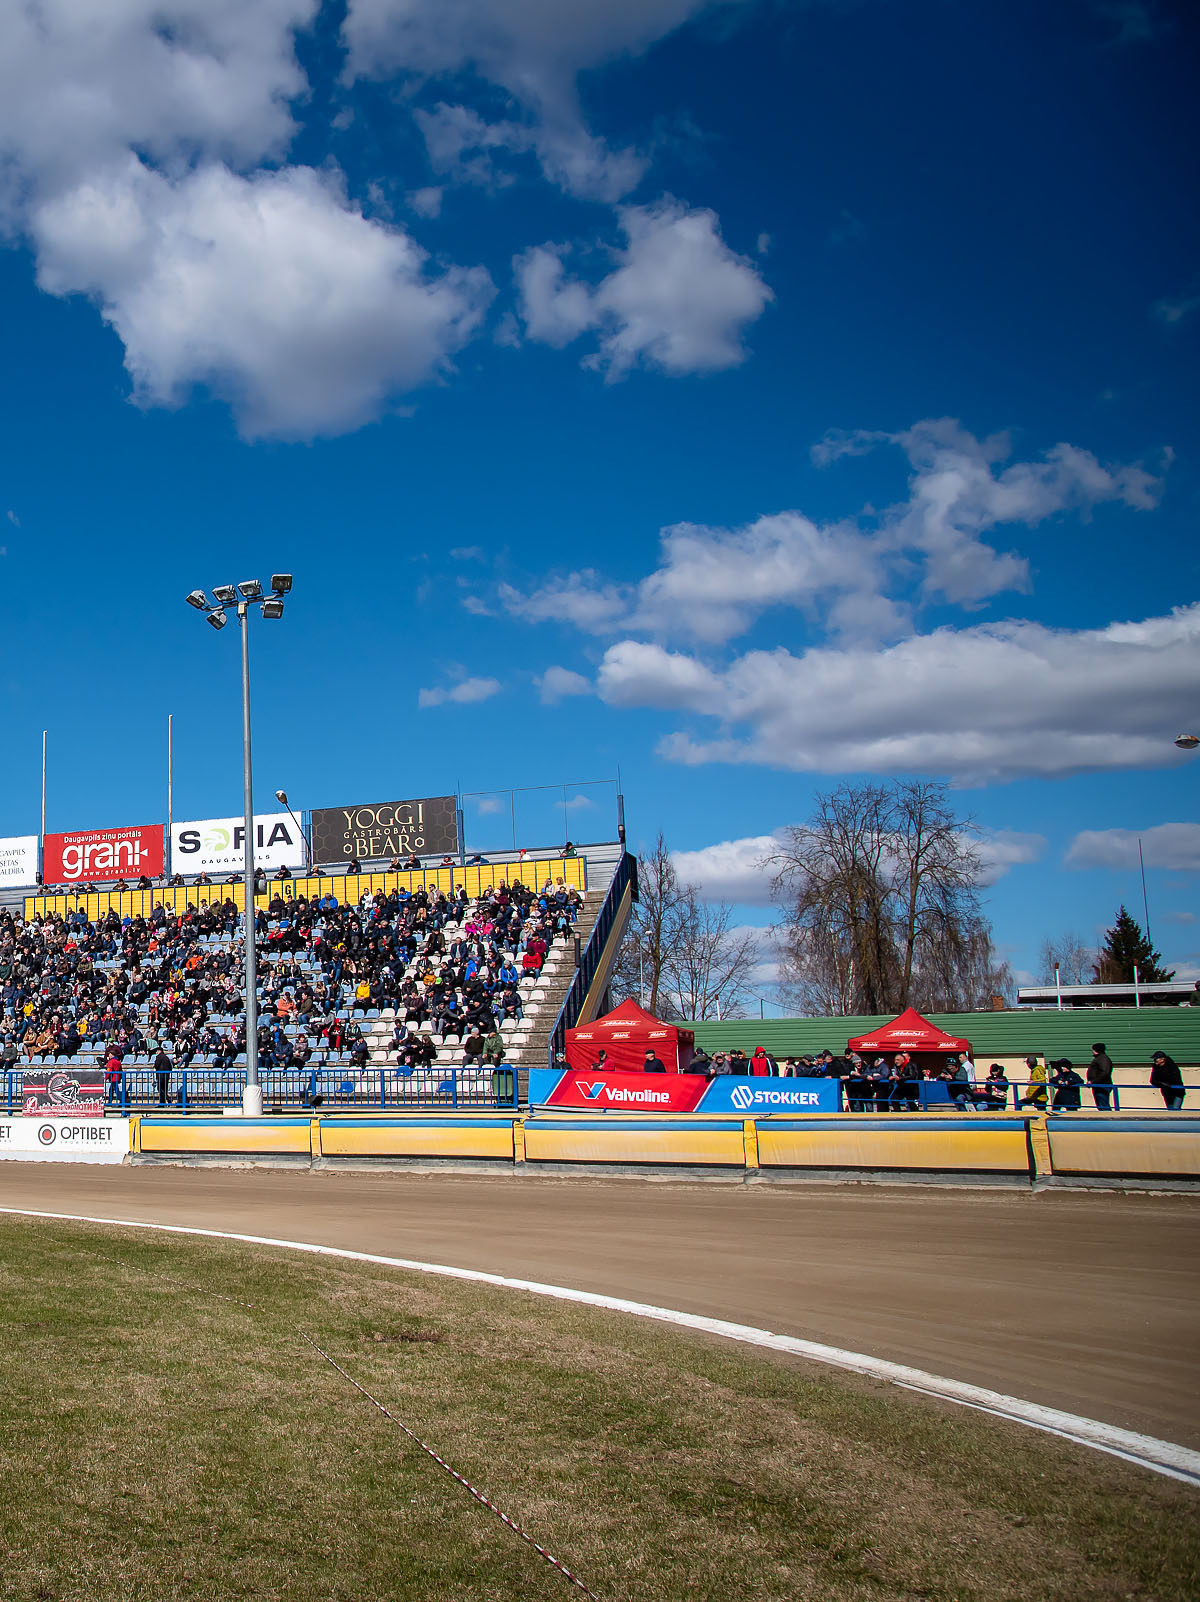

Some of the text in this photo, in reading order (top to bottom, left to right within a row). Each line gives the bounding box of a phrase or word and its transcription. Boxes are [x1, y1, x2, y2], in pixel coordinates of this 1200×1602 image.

[343, 803, 424, 830] YOGGI
[64, 834, 101, 844] Daugavpils
[356, 834, 416, 858] BEAR
[62, 840, 140, 879] grani
[201, 855, 270, 865] DAUGAVILS
[754, 1091, 819, 1106] STOKKER
[60, 1126, 113, 1141] OPTIBET
